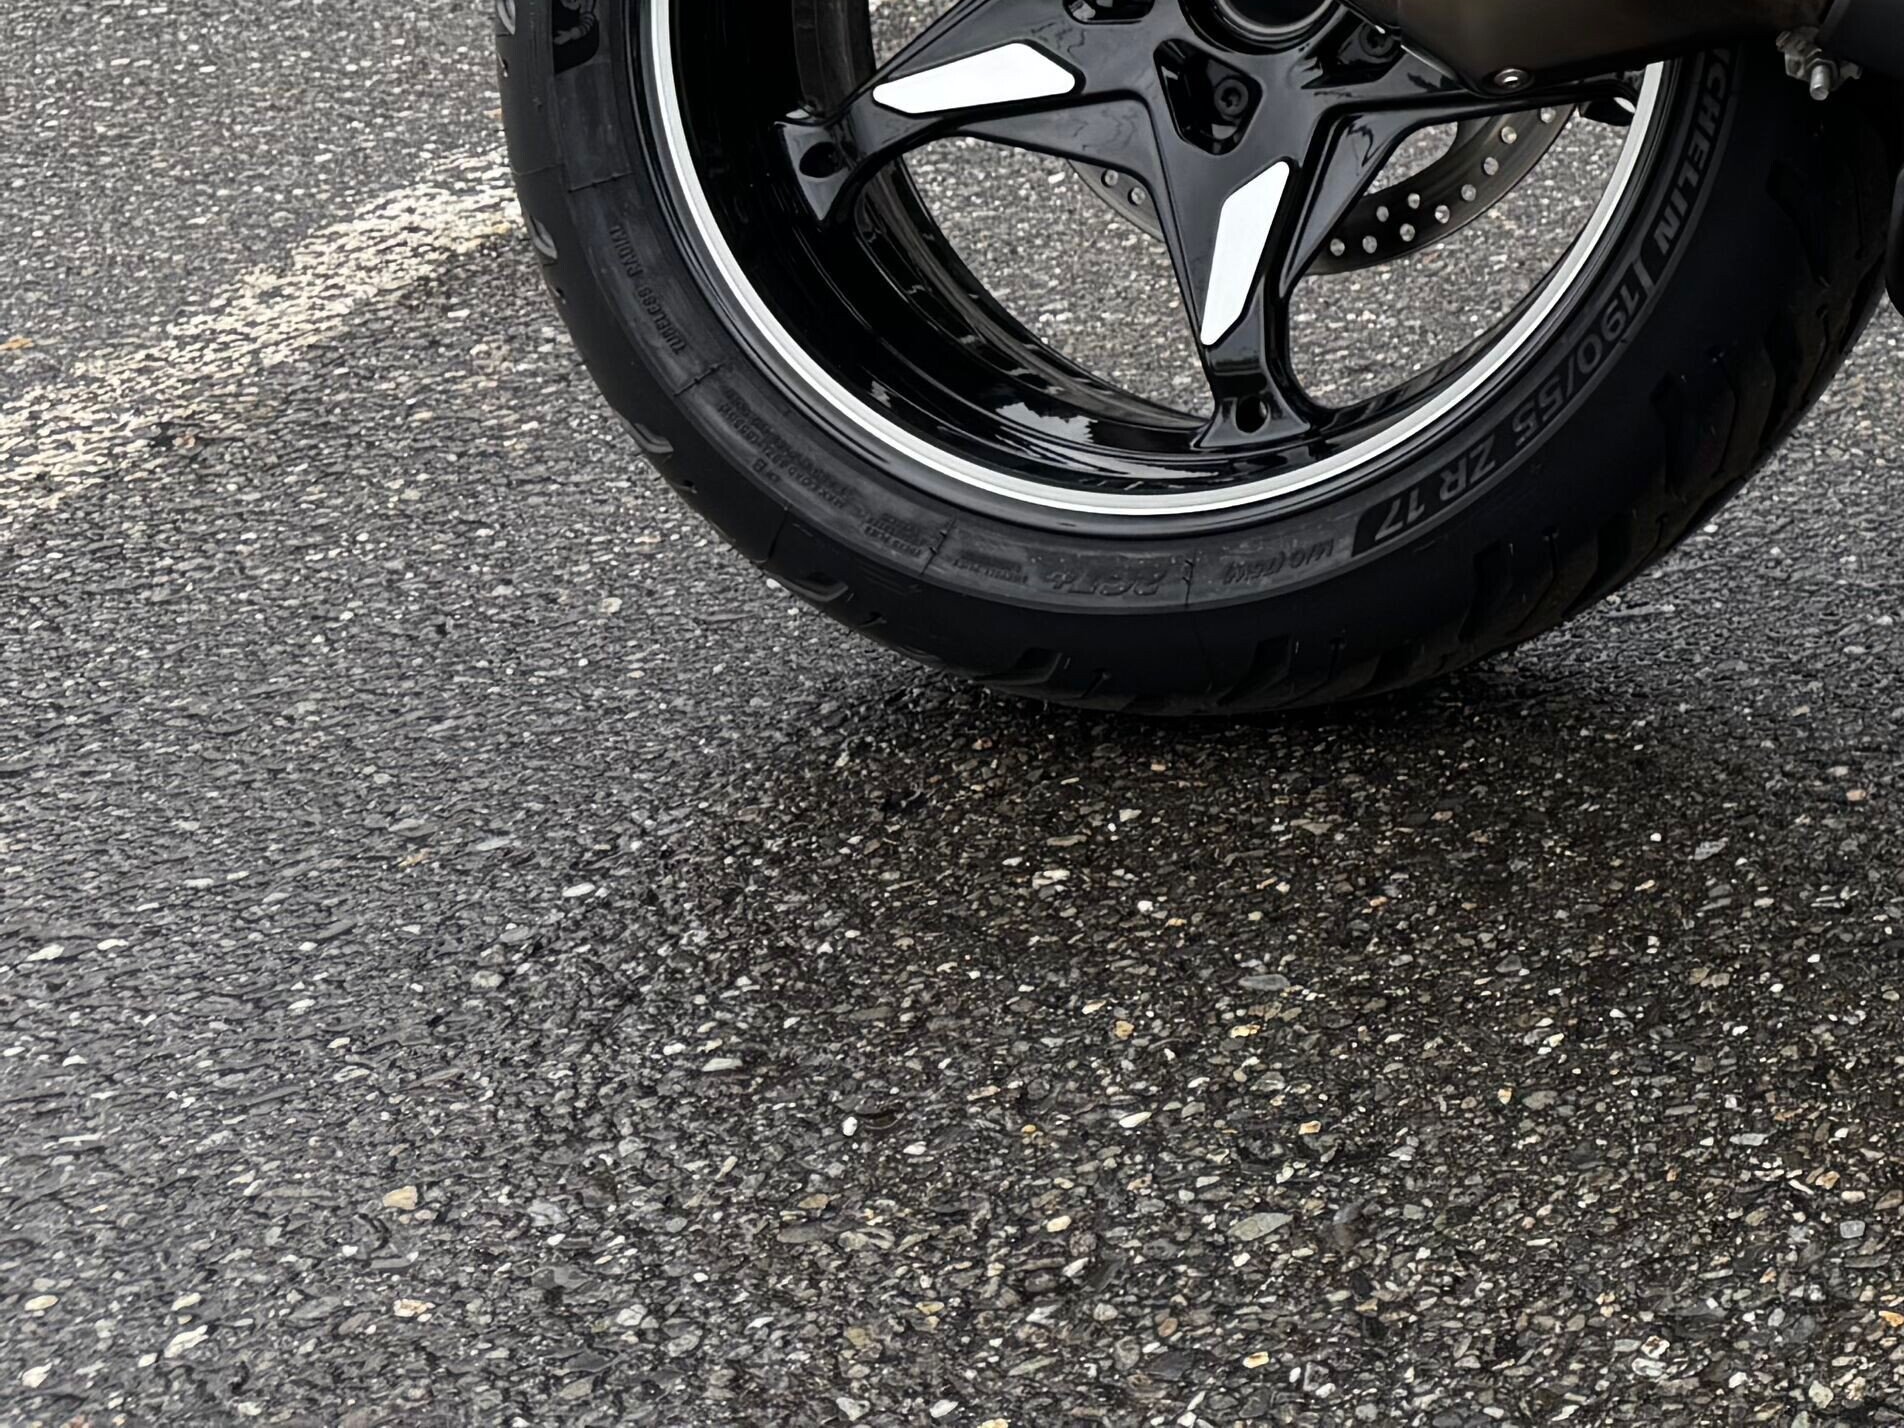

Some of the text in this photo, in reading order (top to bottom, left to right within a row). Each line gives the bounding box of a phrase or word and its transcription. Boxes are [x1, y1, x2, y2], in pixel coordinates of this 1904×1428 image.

[1511, 284, 1640, 447] 190/55
[1438, 434, 1497, 502] ZR
[1374, 488, 1425, 543] 17
